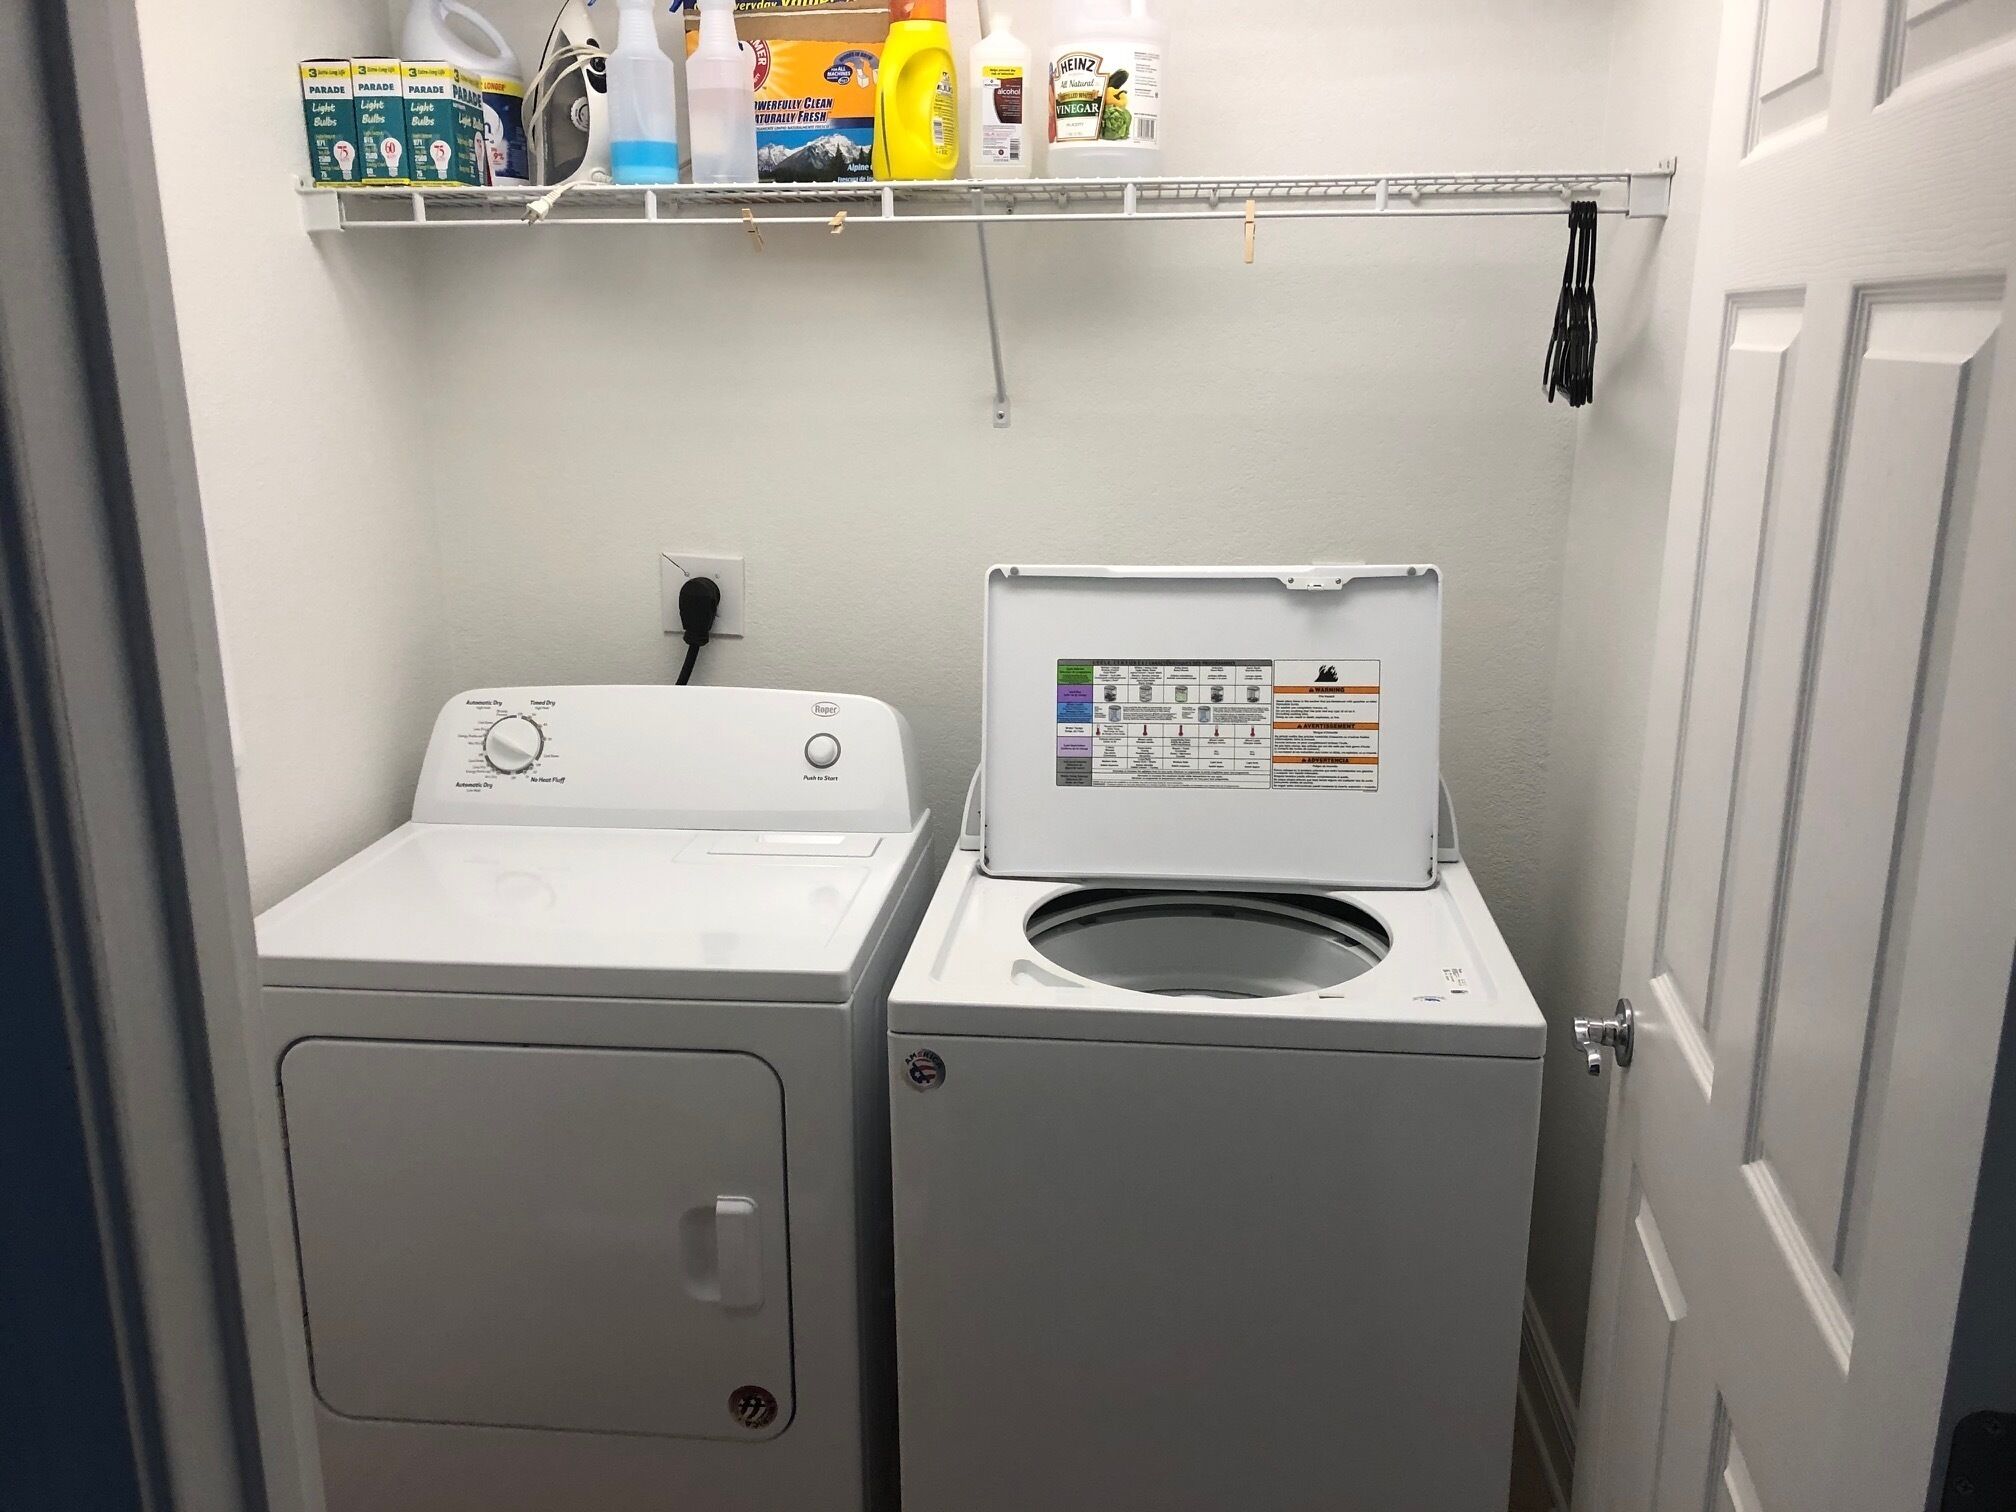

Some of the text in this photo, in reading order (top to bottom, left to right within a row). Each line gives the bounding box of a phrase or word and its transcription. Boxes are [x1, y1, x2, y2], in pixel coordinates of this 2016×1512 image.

[358, 65, 367, 75] 3
[1060, 57, 1096, 75] HEINZ
[308, 68, 318, 78] 3
[408, 68, 418, 78] 3
[453, 68, 460, 83] 3
[358, 83, 395, 91] PARADE
[1069, 78, 1095, 89] Natural
[309, 86, 346, 94] PARADE
[408, 85, 445, 94] PARADE
[452, 84, 483, 108] PARADE
[312, 102, 336, 115] Light
[361, 99, 385, 112] Light
[410, 102, 435, 114] Light
[755, 97, 833, 110] WERFULLY CLEAN
[1056, 102, 1099, 115] VINEGAR
[314, 116, 338, 127] Bulbs
[362, 113, 386, 124] Bulbs
[411, 116, 435, 126] Bulbs
[755, 110, 827, 124] ATURALLY FRESH
[337, 145, 349, 159] 75
[384, 141, 396, 154] 60
[433, 144, 445, 156] 75
[847, 163, 870, 173] Alpine
[493, 699, 503, 707] Dry
[814, 705, 838, 715] Roper
